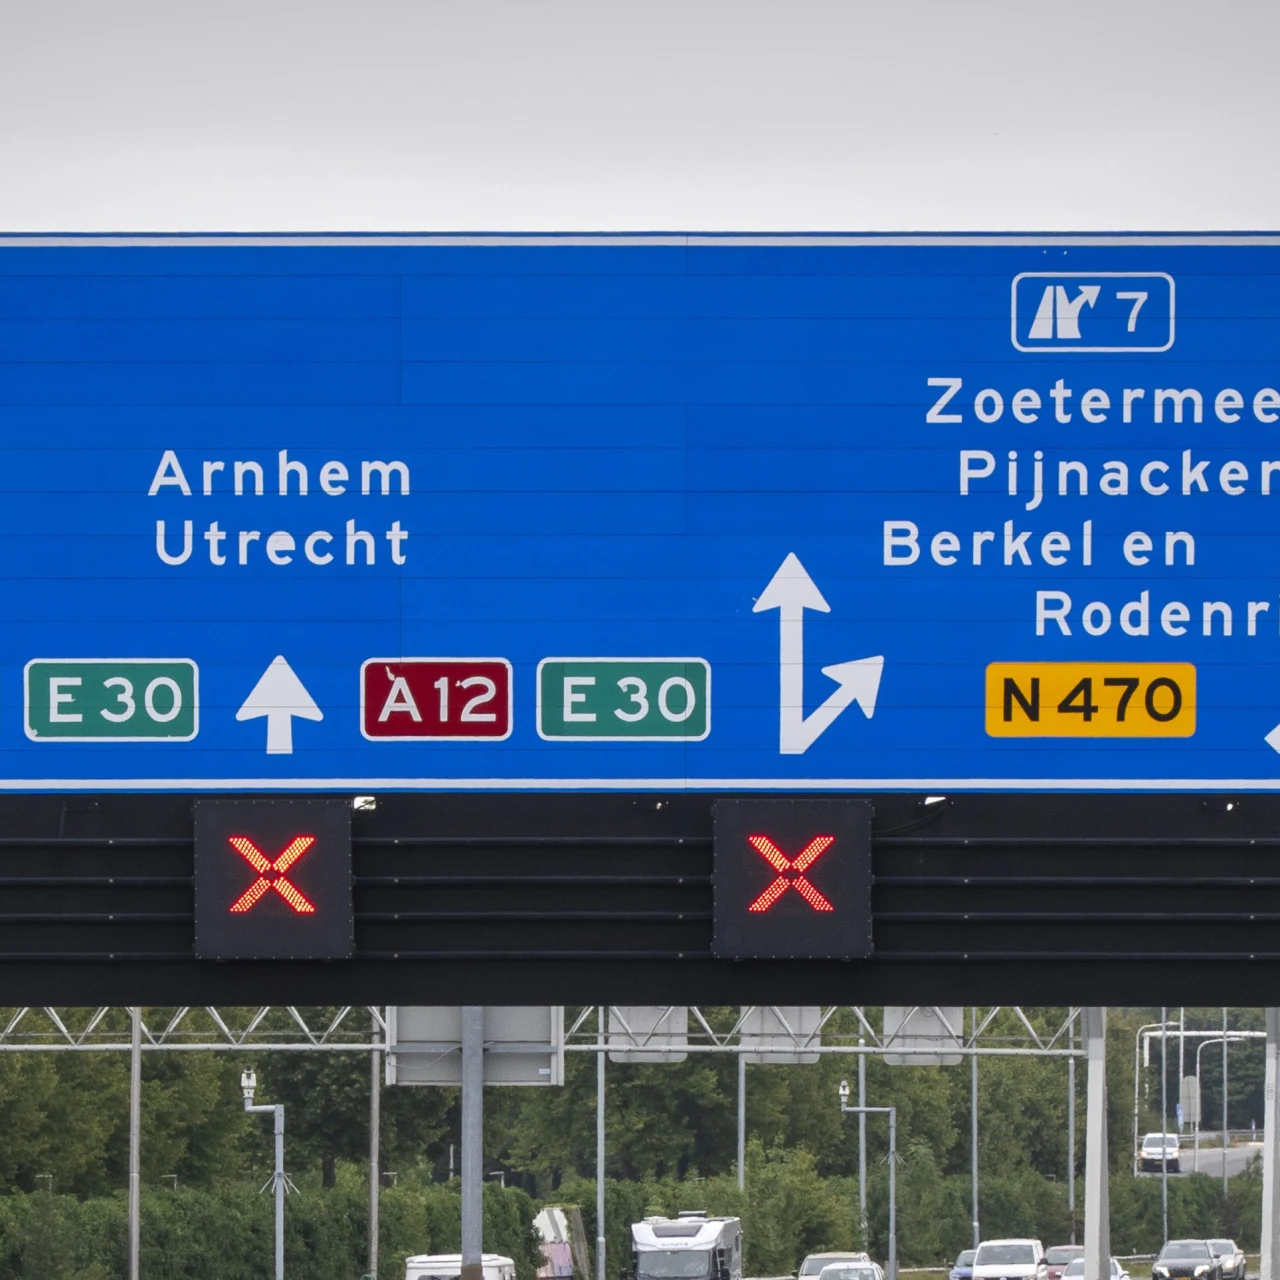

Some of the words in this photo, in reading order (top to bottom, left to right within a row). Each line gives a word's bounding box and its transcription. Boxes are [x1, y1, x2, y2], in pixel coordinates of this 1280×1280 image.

[1116, 291, 1148, 332] 7
[147, 449, 410, 496] Arnhem
[156, 518, 409, 566] Utrecht
[883, 519, 1092, 566] Berkel
[1123, 530, 1195, 566] en
[377, 676, 497, 723] A12
